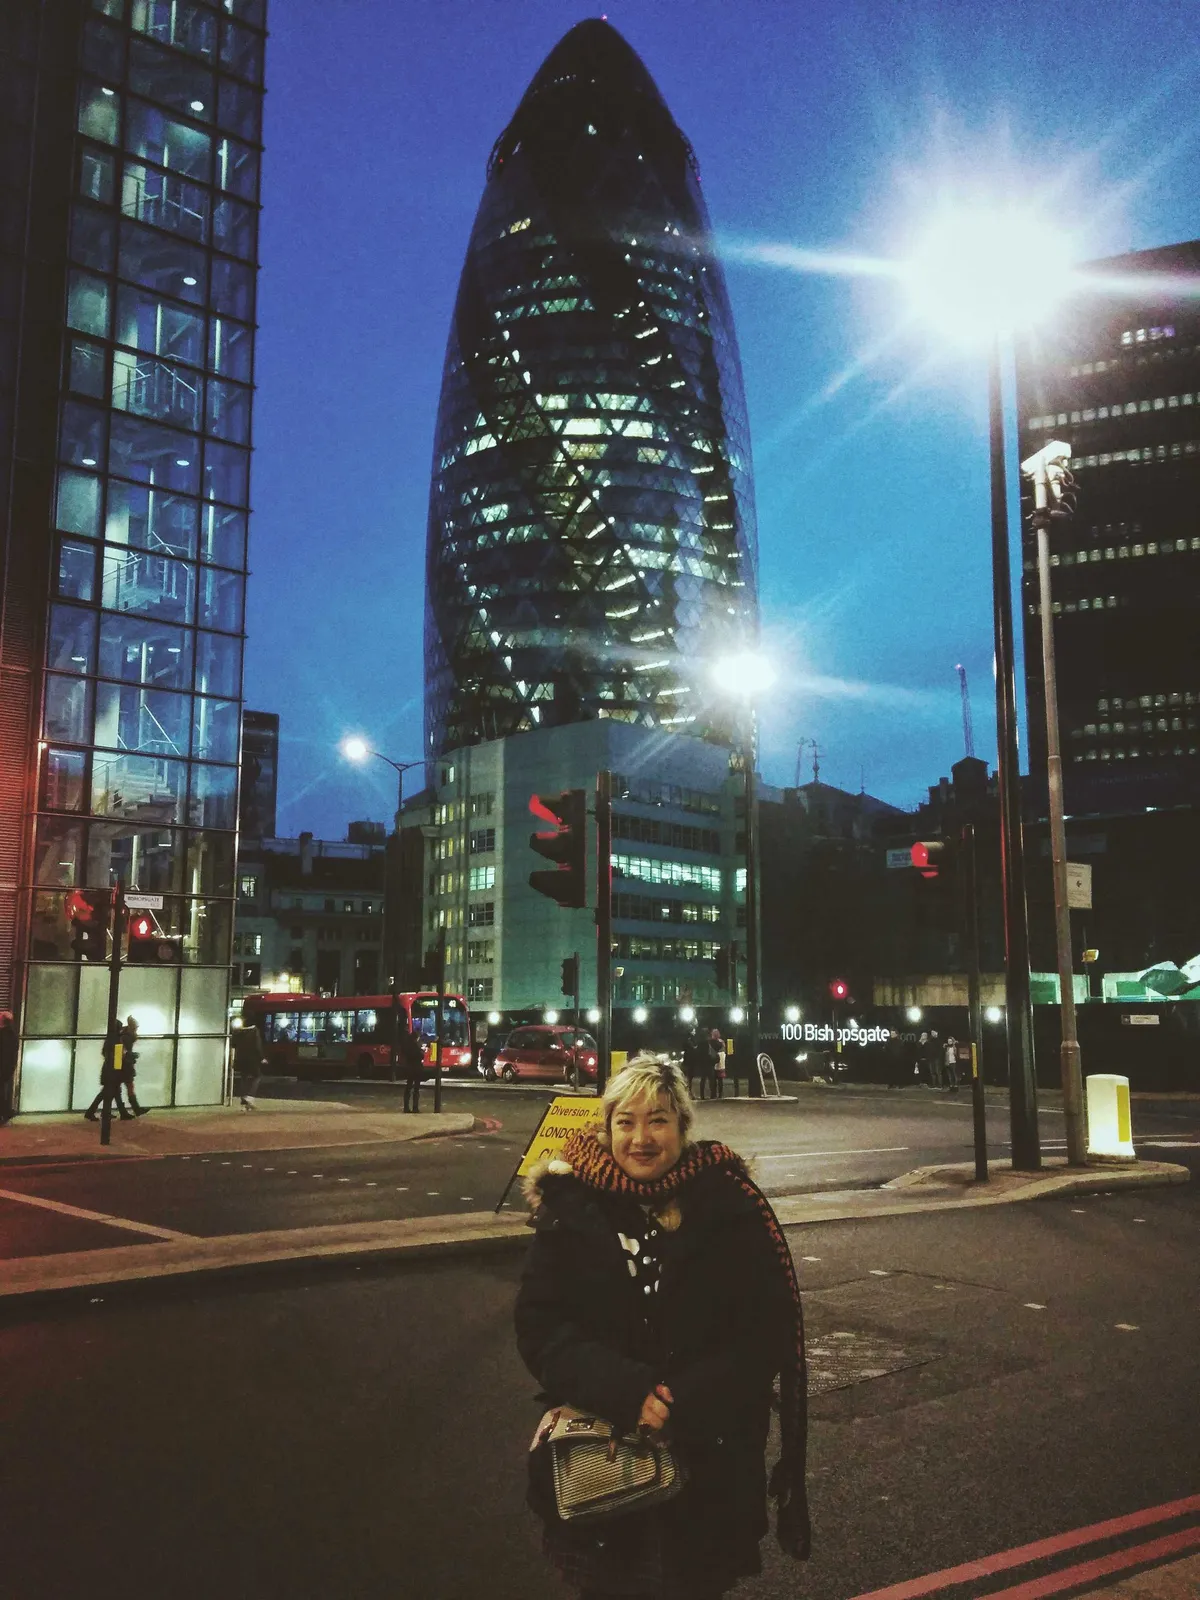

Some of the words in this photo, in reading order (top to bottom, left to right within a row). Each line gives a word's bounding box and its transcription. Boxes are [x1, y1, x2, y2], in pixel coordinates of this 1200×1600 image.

[781, 1024, 802, 1041] 100
[804, 1024, 891, 1047] Bishopsgate
[550, 1105, 590, 1117] Diversion
[540, 1126, 582, 1139] LONDO
